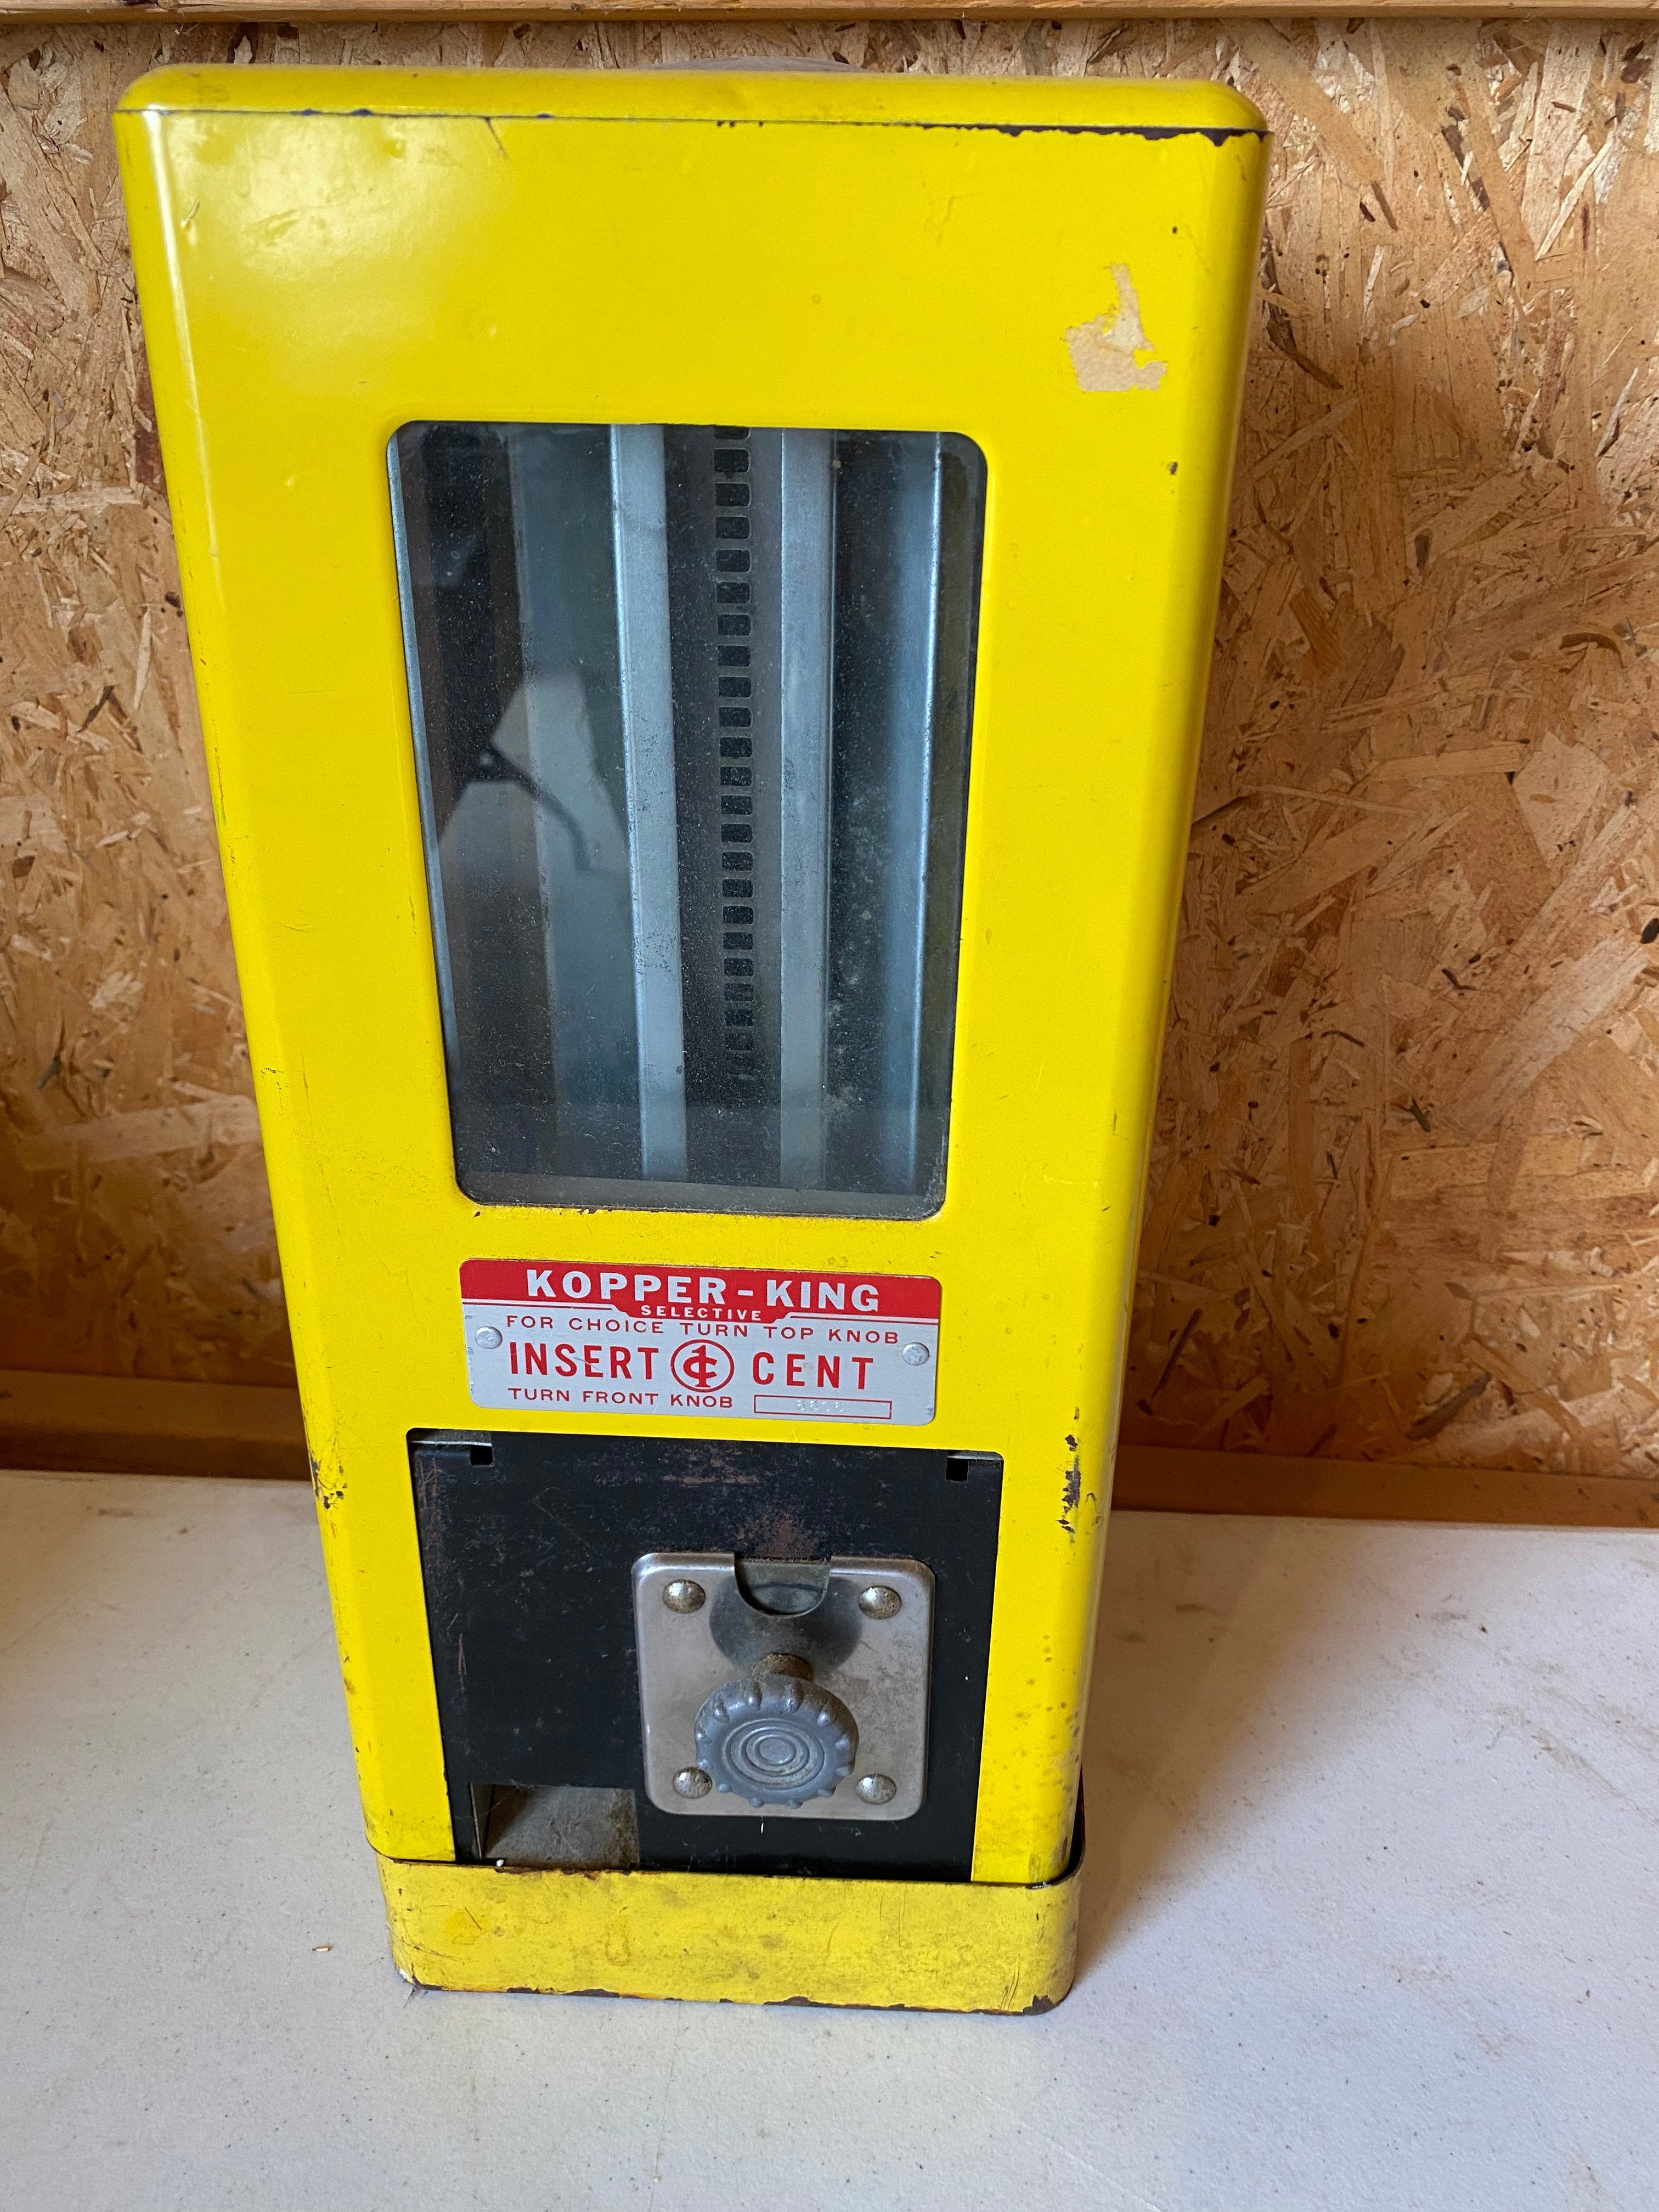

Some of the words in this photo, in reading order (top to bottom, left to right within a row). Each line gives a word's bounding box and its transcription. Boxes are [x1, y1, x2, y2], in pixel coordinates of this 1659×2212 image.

[641, 1305, 761, 1322] SELECTIVE
[507, 1315, 553, 1328] FOR
[569, 1317, 663, 1334] CHOICE
[680, 1322, 747, 1337] TURN
[764, 1326, 814, 1339] TOP
[828, 1329, 898, 1344] KNOB
[510, 1341, 659, 1380] INSERT
[753, 1352, 873, 1390] CENT
[509, 1388, 569, 1402] TURN
[583, 1391, 658, 1405] FRONT
[670, 1395, 732, 1408] KNOB
